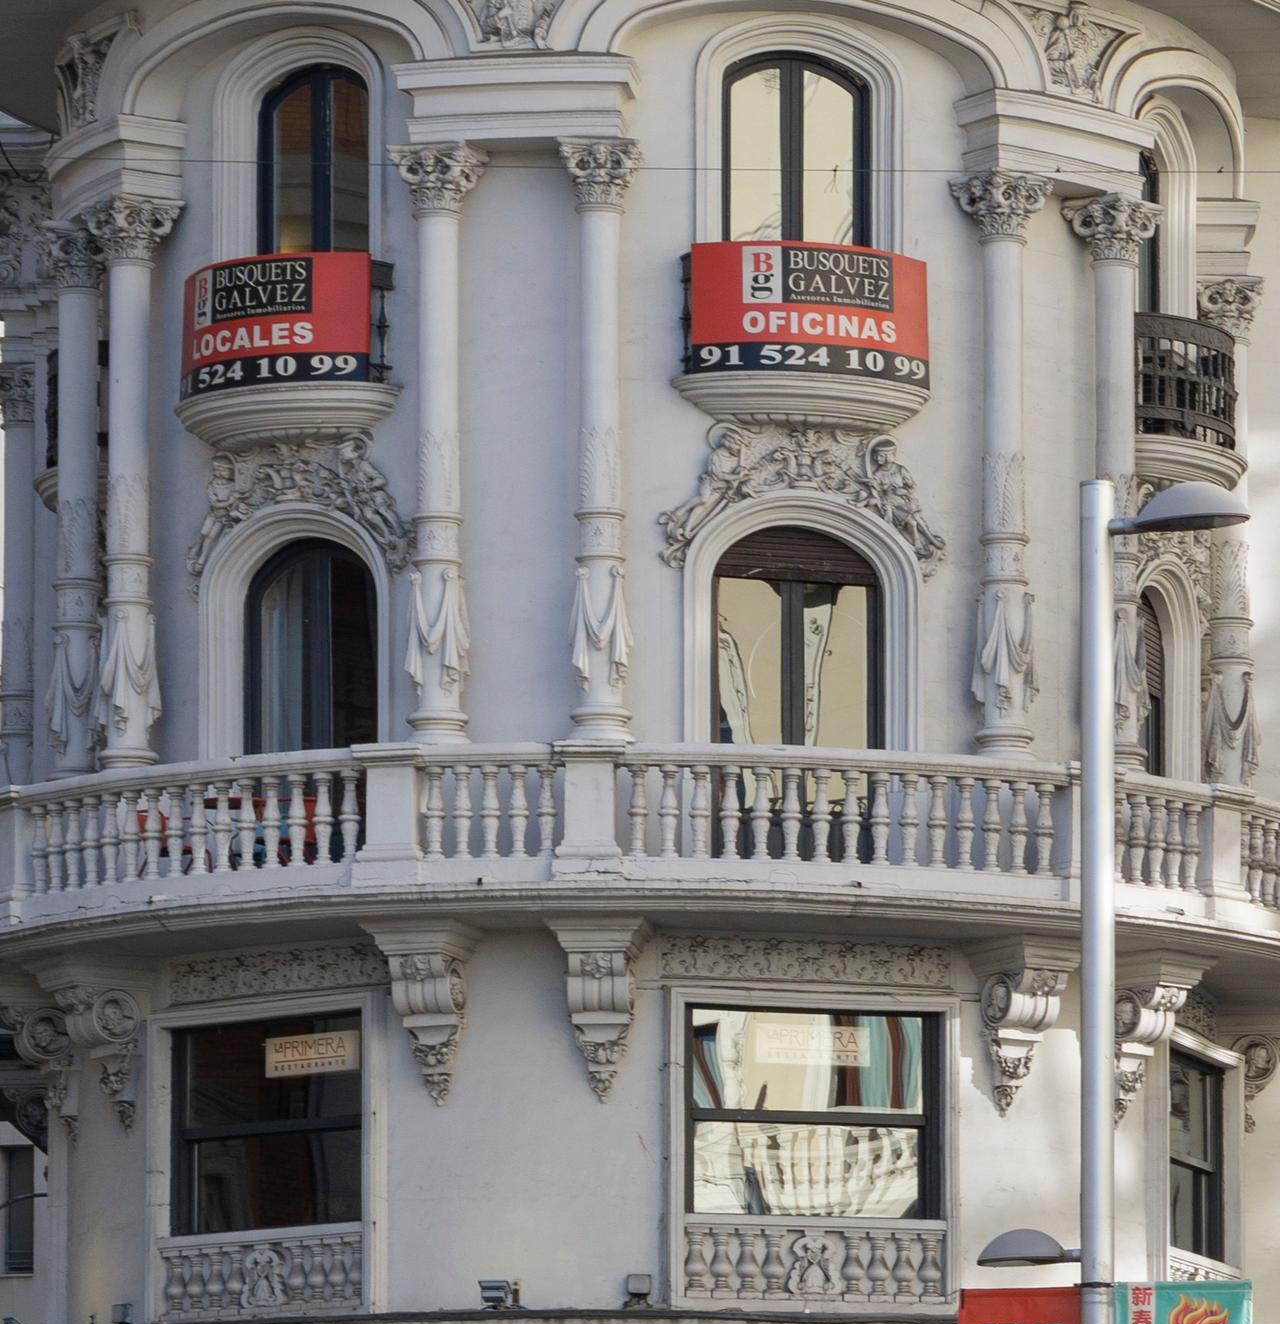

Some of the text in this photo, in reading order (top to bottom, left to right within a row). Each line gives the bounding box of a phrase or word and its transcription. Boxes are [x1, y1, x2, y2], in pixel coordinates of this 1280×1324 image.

[215, 261, 307, 289] BUSQUETS
[789, 250, 890, 277] BUSQUETS
[215, 283, 306, 311] GALVEZ
[788, 273, 890, 301] GALVEZ
[216, 304, 306, 320] Asesores Inmobiliarios
[790, 293, 890, 310] Asesores Inmobiliarios
[192, 321, 314, 360] LOCALES
[742, 311, 897, 343] OFICINAS
[197, 361, 243, 388] 524
[256, 355, 297, 378] 10
[310, 355, 358, 376] 99
[699, 345, 926, 379] 91 524 10 99
[284, 1036, 346, 1059] PRIMERA
